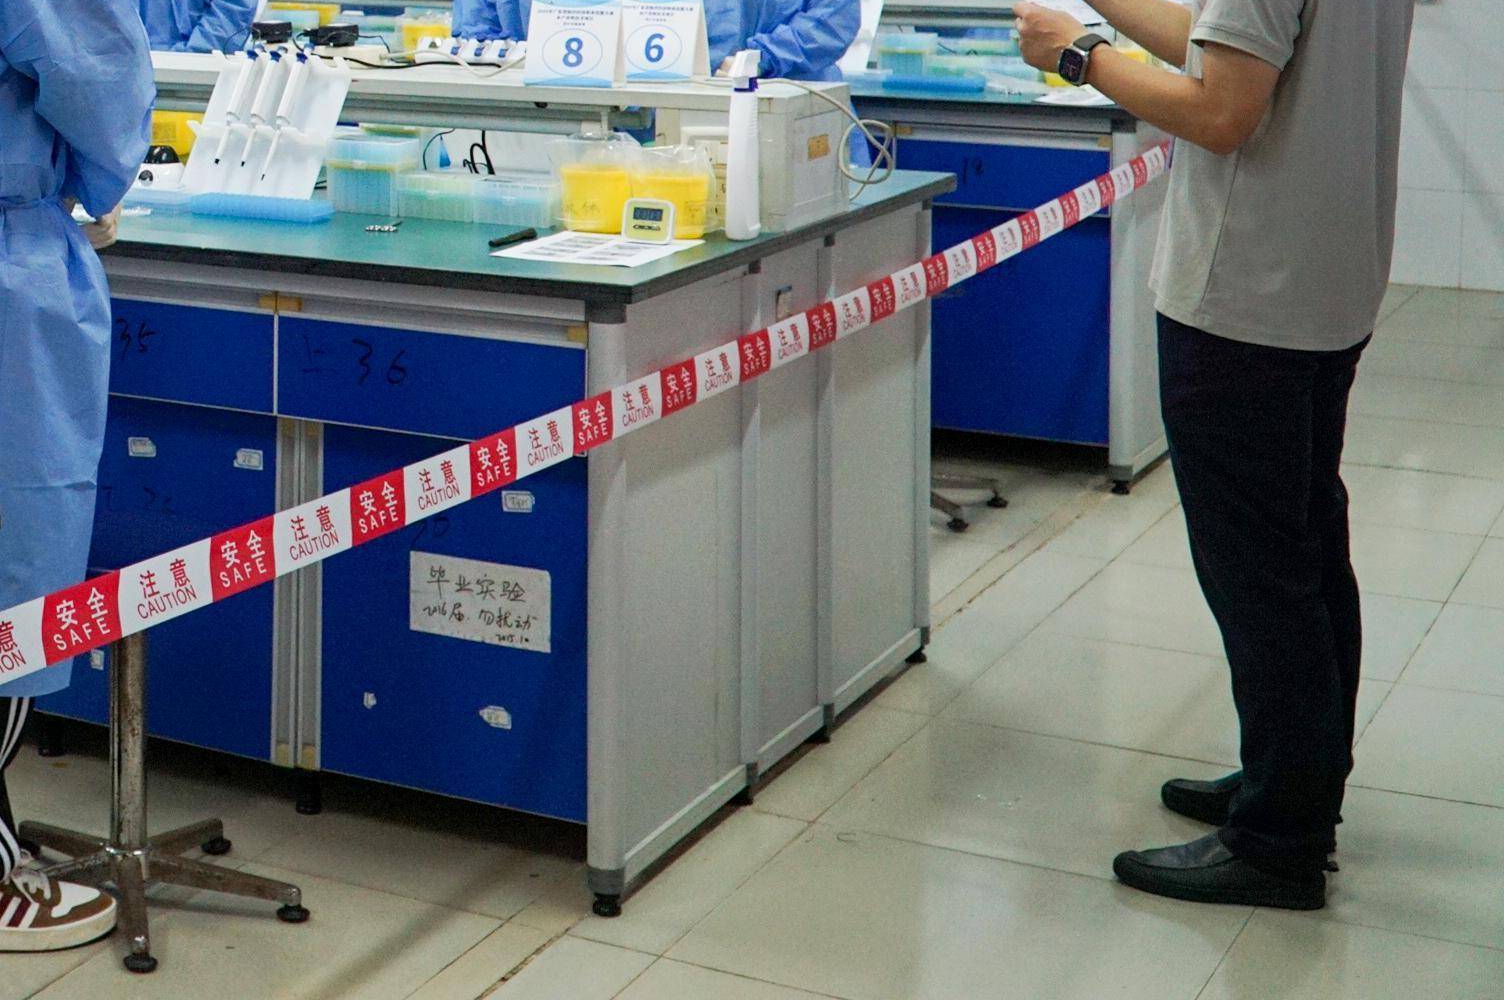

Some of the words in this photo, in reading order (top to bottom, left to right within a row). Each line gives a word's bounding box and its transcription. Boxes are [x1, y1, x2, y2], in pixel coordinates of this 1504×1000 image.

[562, 37, 584, 68] 8
[645, 33, 665, 63] 6
[352, 338, 407, 385] 36
[704, 352, 731, 378] 注意
[666, 366, 693, 394] 安全
[622, 384, 651, 412] 注意
[666, 388, 693, 409] SAFE
[578, 400, 608, 430] 安全
[622, 404, 655, 427] CAUTION
[528, 420, 562, 450] 注意
[578, 425, 608, 446] SAFE
[477, 438, 511, 470] 安全
[527, 441, 565, 467] CAUTION
[419, 459, 456, 492] 注意
[477, 461, 512, 487] SAFE
[359, 481, 398, 517] 安全
[417, 482, 461, 511] CAUTION
[290, 505, 333, 542] 注意
[358, 506, 400, 535] SAFE
[221, 529, 266, 568] 安全
[288, 528, 340, 562] CAUTION
[140, 557, 191, 600] 注意
[219, 557, 267, 589] SAFE
[426, 565, 527, 603] 毕业实验
[56, 587, 109, 632] 安全
[137, 584, 198, 621] CAUTION
[53, 617, 111, 652] SAFE
